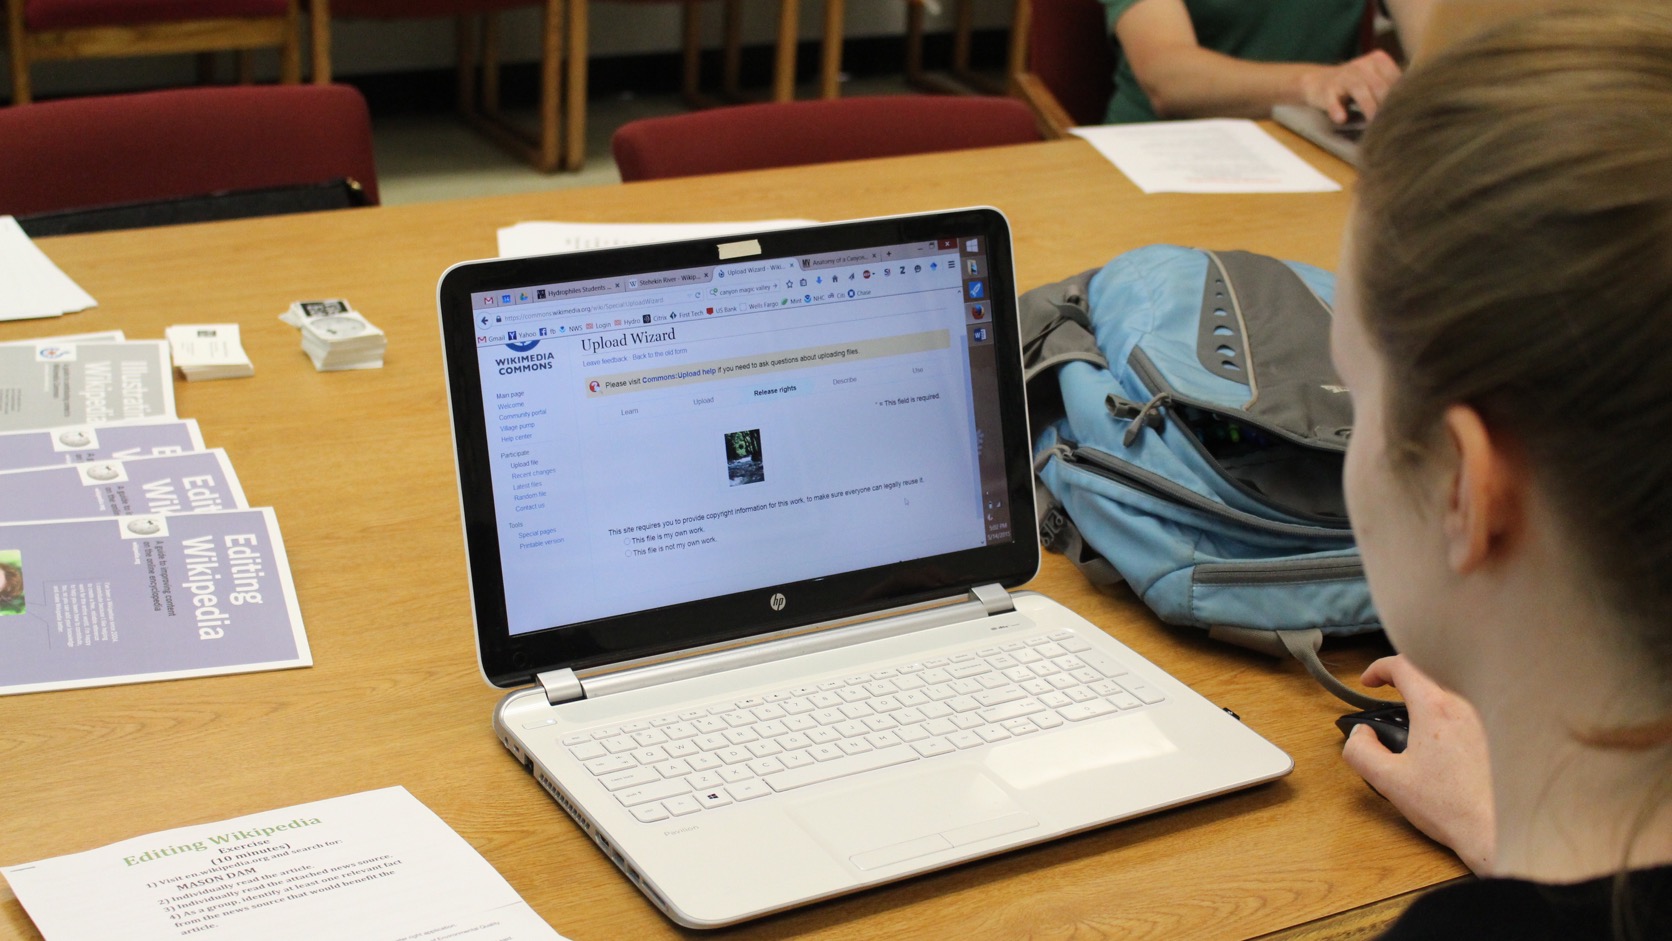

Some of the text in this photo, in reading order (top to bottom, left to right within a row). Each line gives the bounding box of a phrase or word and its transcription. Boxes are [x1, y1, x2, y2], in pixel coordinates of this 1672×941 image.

[727, 265, 765, 276] Upload Wizard
[639, 278, 662, 286] Stehekin
[547, 284, 605, 297] Hydrophiles Students
[623, 318, 640, 326] Hydro
[488, 334, 505, 342] Gmail
[581, 326, 675, 353] Upload Wizard
[494, 352, 554, 366] WIKIMEDIA
[582, 355, 627, 367] Leave feedback
[632, 352, 646, 360] Back
[498, 361, 552, 375] COMMONS
[605, 380, 626, 388] Please
[641, 369, 701, 383] Commons:Upload
[701, 367, 716, 375] help
[722, 366, 734, 374] you
[734, 362, 750, 370] need
[770, 357, 798, 366] questions
[817, 350, 845, 360] uploading
[753, 385, 796, 396] Release rights
[497, 401, 524, 409] Welcome
[693, 396, 714, 405] Upload
[498, 408, 546, 420] Community portal
[500, 450, 529, 458] Participate
[510, 460, 529, 469] Upload
[635, 522, 661, 531] requires
[662, 520, 673, 528] you
[682, 514, 704, 524] provide
[705, 509, 733, 519] copyright
[734, 504, 767, 514] information
[844, 486, 870, 496] everyone
[883, 481, 901, 490] legally
[145, 549, 153, 558] the
[155, 546, 167, 559] guide
[146, 558, 156, 574] online
[224, 533, 265, 607] Editing
[159, 567, 172, 595] improving
[182, 535, 230, 641] Wikipedia
[149, 575, 162, 612] encyclopedia
[165, 595, 176, 617] content
[771, 593, 785, 610] hp
[122, 817, 322, 866] Editing Wikipedia
[217, 839, 269, 854] Exercise
[210, 842, 290, 865] (10 minutes)
[158, 875, 183, 884] Visit
[184, 856, 270, 879] en.wikipedia.org
[270, 850, 289, 859] and
[290, 843, 324, 853] search
[170, 883, 233, 901] Individually
[235, 876, 260, 886] read
[279, 865, 314, 875] article.
[176, 867, 256, 891] MASON DAM
[176, 890, 239, 909] Individually
[241, 883, 265, 893] read
[285, 868, 328, 882] attached
[329, 862, 356, 872] news
[357, 854, 393, 865] source.
[206, 900, 241, 912] group,
[241, 889, 280, 902] identify
[294, 879, 319, 889] least
[341, 864, 383, 878] relevant
[383, 859, 402, 867] fact
[174, 918, 201, 927] from
[221, 906, 249, 916] news
[250, 897, 285, 909] source
[286, 891, 308, 900] that
[309, 882, 341, 894] would
[341, 874, 377, 886] benefit
[180, 923, 218, 935] article.
